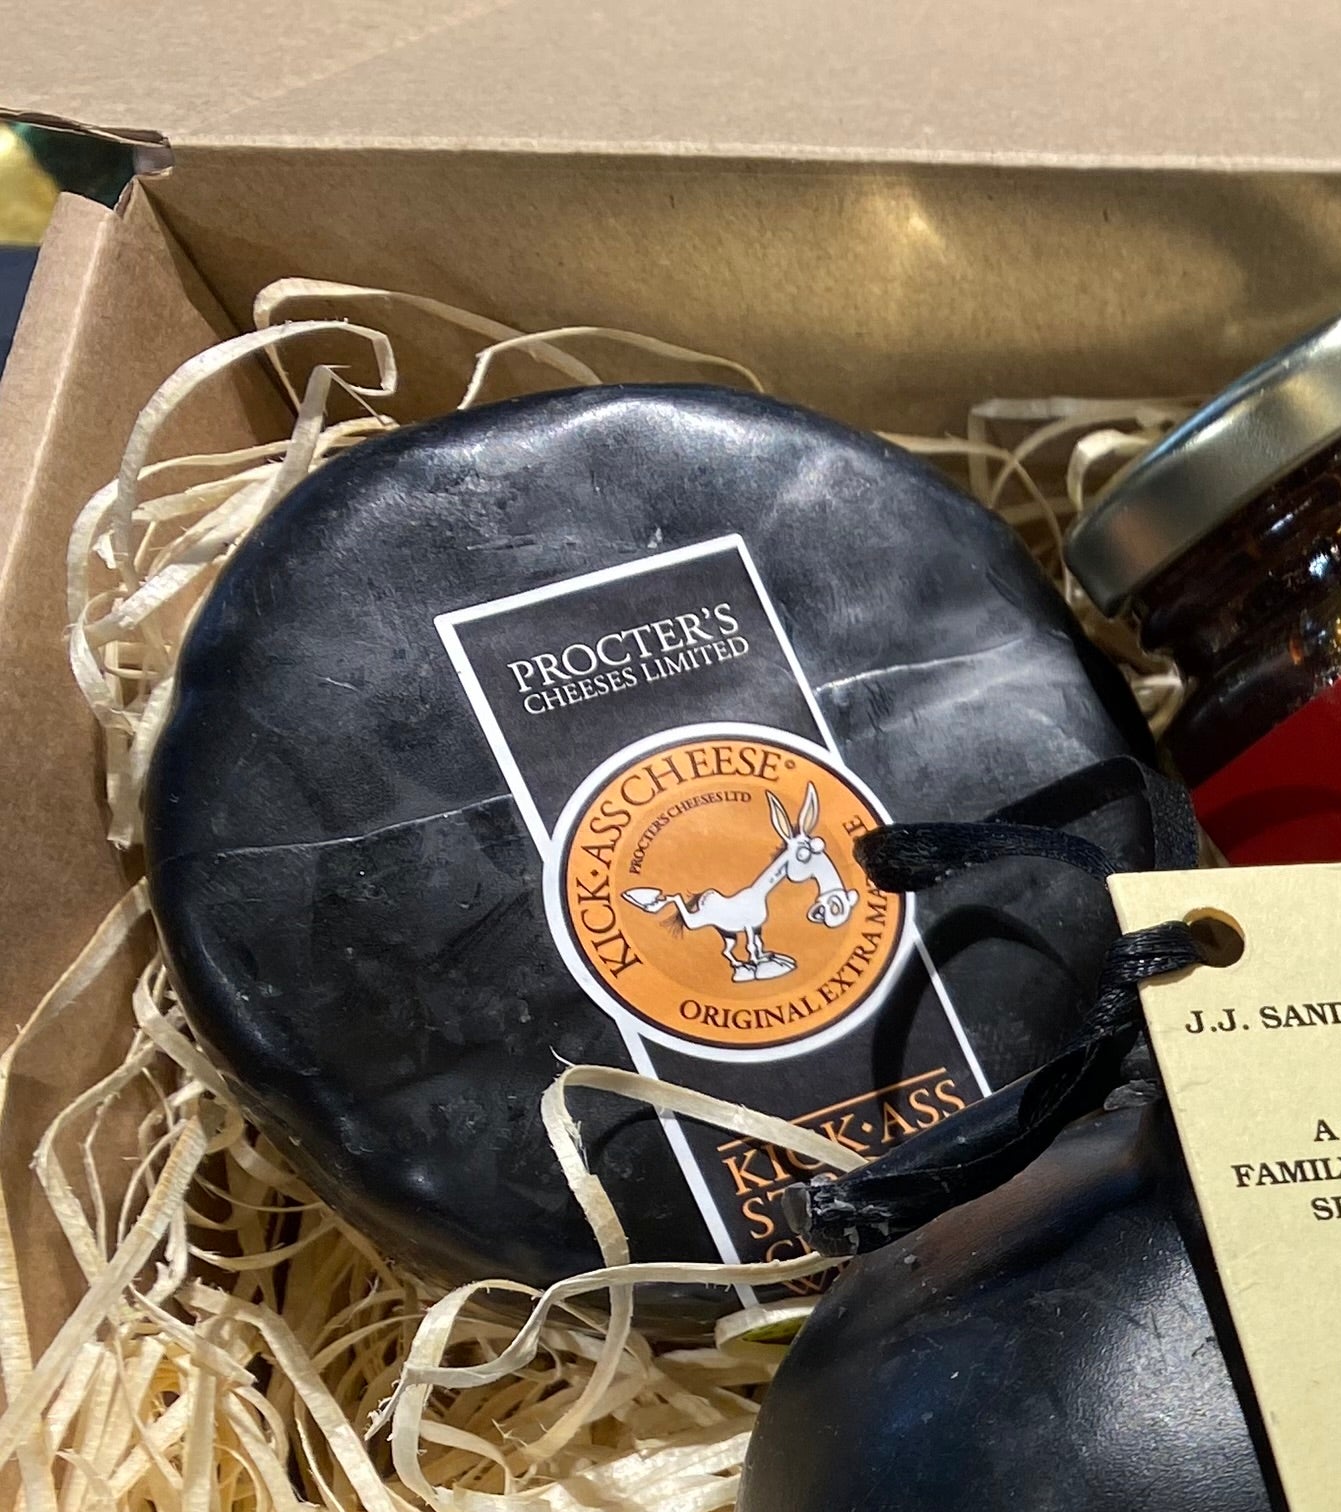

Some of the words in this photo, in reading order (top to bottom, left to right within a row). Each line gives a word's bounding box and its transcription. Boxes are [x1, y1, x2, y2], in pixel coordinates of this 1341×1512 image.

[507, 603, 739, 693] PROCTER'S
[523, 667, 637, 715] CHEESES
[641, 636, 749, 682] LIMITED
[667, 791, 726, 819] CHEESES
[724, 790, 752, 803] LTD
[680, 998, 821, 1030] ORIGINAL
[817, 926, 884, 1006] EXTRA
[1185, 1008, 1250, 1034] J.J.
[1313, 1119, 1339, 1142] A
